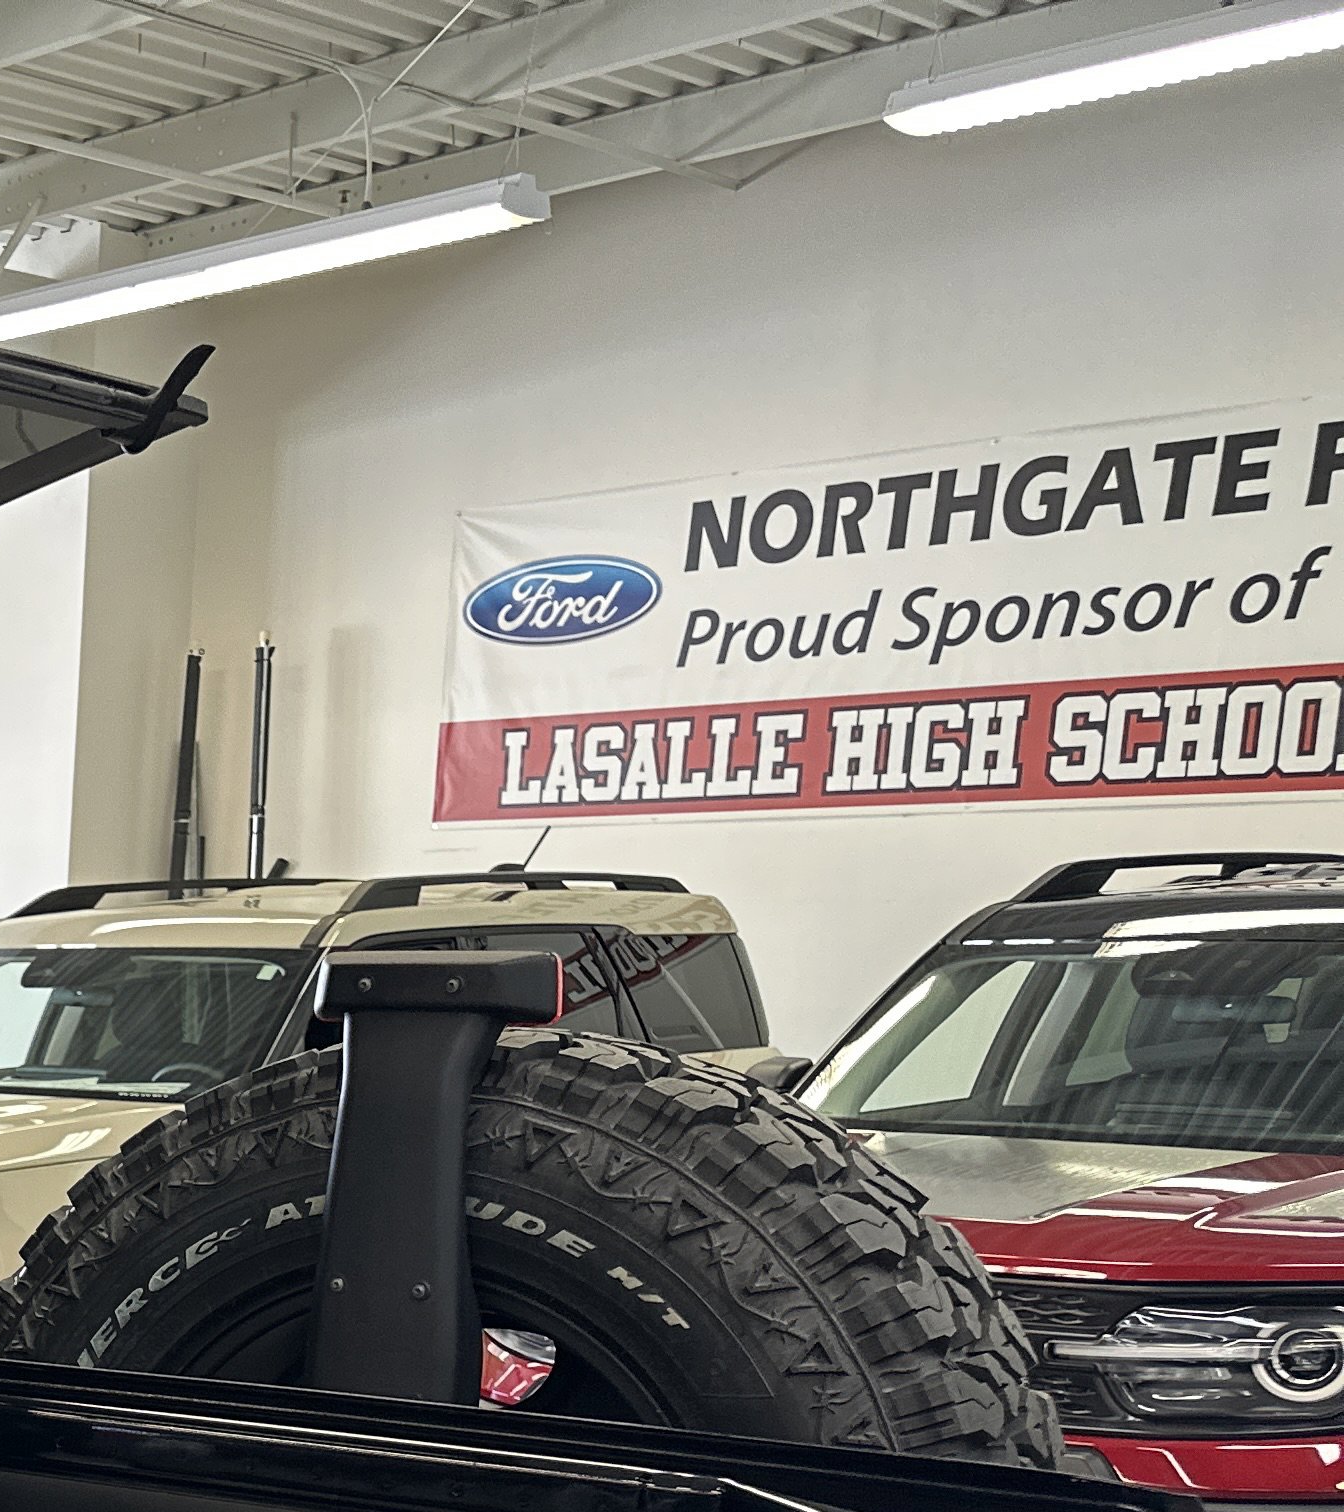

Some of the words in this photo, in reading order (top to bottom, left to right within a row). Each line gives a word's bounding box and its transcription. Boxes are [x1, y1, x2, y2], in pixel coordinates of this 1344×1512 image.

[684, 427, 1281, 573] NORTHGATE
[497, 569, 624, 632] Ford
[676, 589, 880, 668] Proud
[891, 574, 1212, 665] Sponsor
[1230, 545, 1333, 624] of
[498, 708, 806, 808] LASALLE
[823, 695, 1029, 794] HIGH
[1045, 678, 1344, 788] SCHOO
[76, 1217, 252, 1369] IERCE
[264, 1194, 597, 1259] ATUDE
[606, 1265, 691, 1330] M/T
